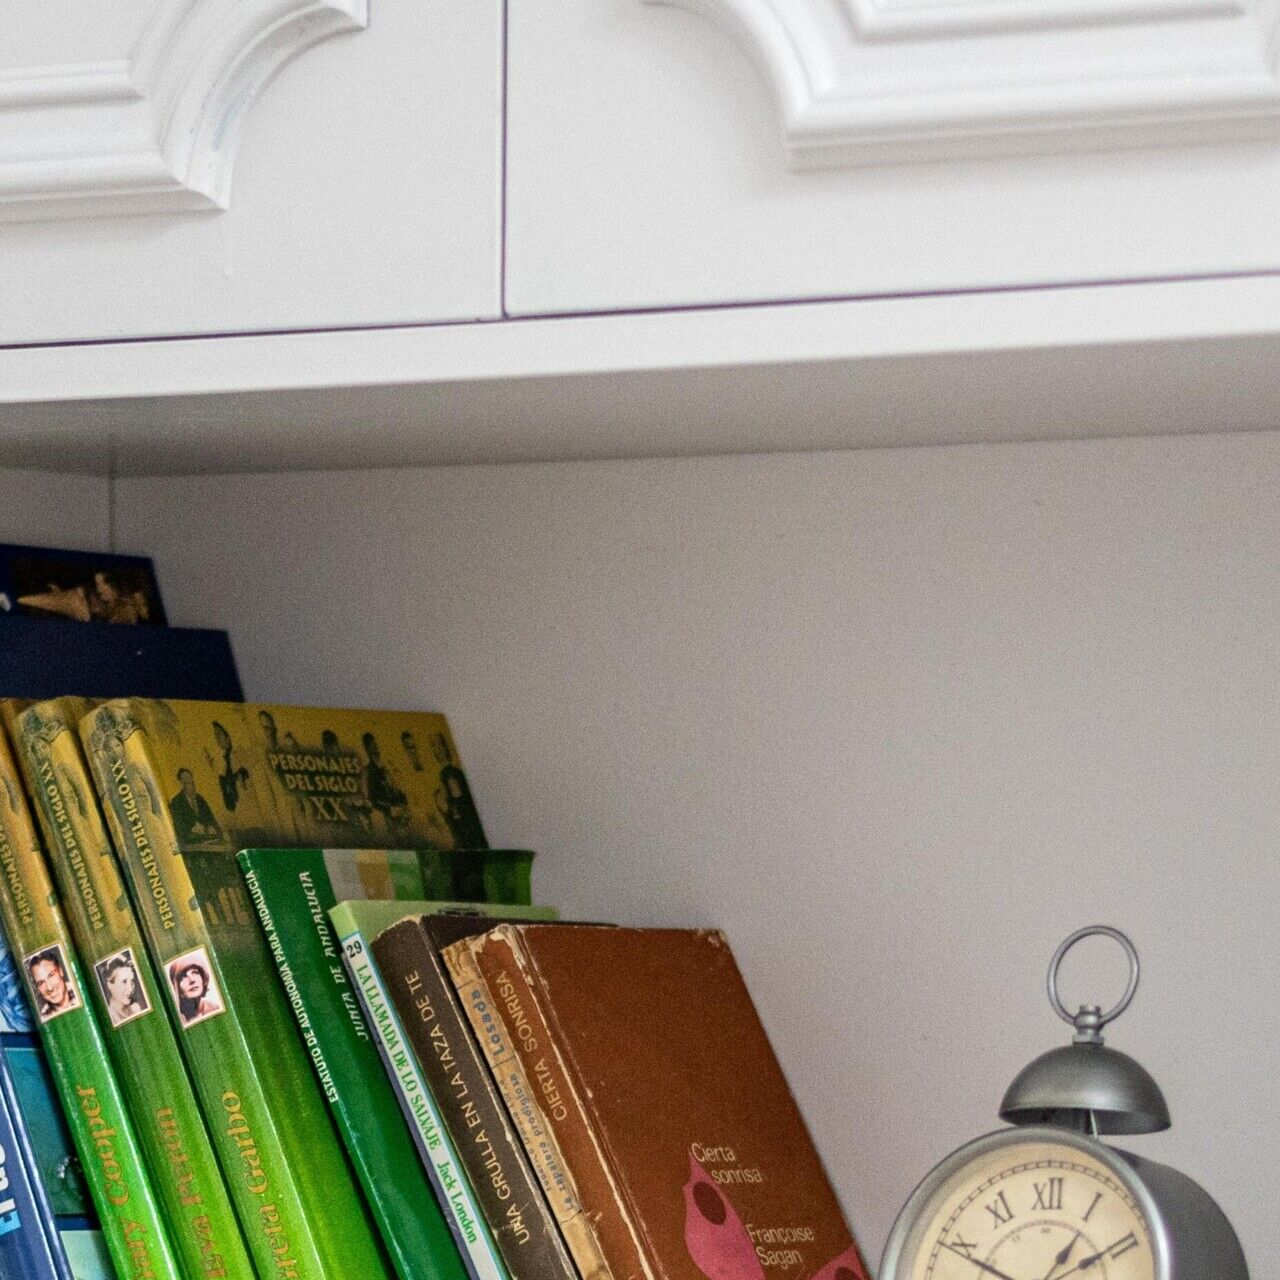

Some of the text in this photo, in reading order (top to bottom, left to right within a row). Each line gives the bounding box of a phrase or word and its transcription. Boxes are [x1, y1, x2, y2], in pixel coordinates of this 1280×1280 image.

[284, 773, 357, 793] DEL SIGLO
[38, 761, 103, 930] PERSONAJES DEL SIGLO XX
[109, 758, 175, 929] PERSONAJES DEL SIGLO XX
[268, 932, 285, 962] PARA
[345, 940, 362, 958] 29
[329, 966, 345, 983] DE
[341, 991, 368, 1039] JUNTA
[304, 1029, 317, 1046] DE
[495, 970, 567, 1121] CIERTA SONRISA
[311, 1046, 339, 1102] ESTATUTO
[356, 964, 476, 1243] LA LLAMADA DE LO SALVAJE Jack London
[404, 970, 530, 1244] UNA GRULLA EN LA TAZA DE TE
[75, 1085, 129, 1206] Cooper
[221, 1089, 268, 1194] Garbo
[692, 1143, 736, 1162] Cierta
[711, 1165, 762, 1184] sonrisa
[985, 1190, 1015, 1229] XI
[1031, 1177, 1064, 1210] XII
[1082, 1192, 1102, 1222] I
[192, 1215, 226, 1278] Eva
[746, 1223, 815, 1244] Françoise
[756, 1246, 803, 1270] Sagan
